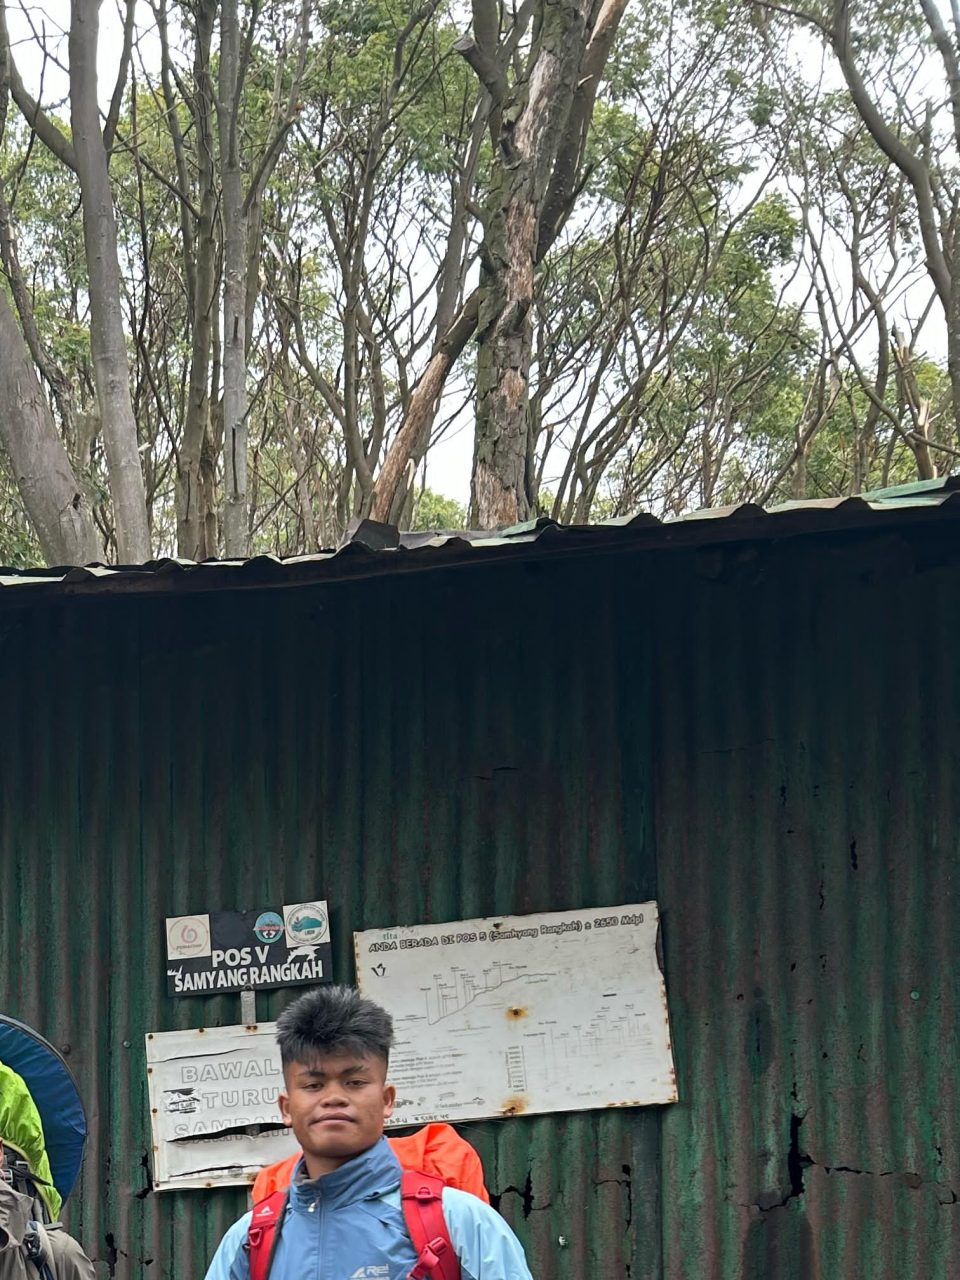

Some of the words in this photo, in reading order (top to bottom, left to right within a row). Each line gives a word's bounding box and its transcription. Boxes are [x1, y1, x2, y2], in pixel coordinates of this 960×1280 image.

[368, 943, 398, 953] ANDA
[399, 936, 439, 950] BERADA
[441, 935, 455, 946] DI
[456, 933, 477, 944] POS
[479, 931, 487, 942] 5
[593, 916, 619, 929] 2650
[621, 913, 644, 927] Mdpl
[212, 947, 253, 968] POS
[255, 945, 270, 964] V
[175, 968, 248, 992] SAMYANG
[249, 960, 323, 985] RANGKAH
[181, 1059, 283, 1083] BAWAL
[202, 1086, 287, 1109] TURU
